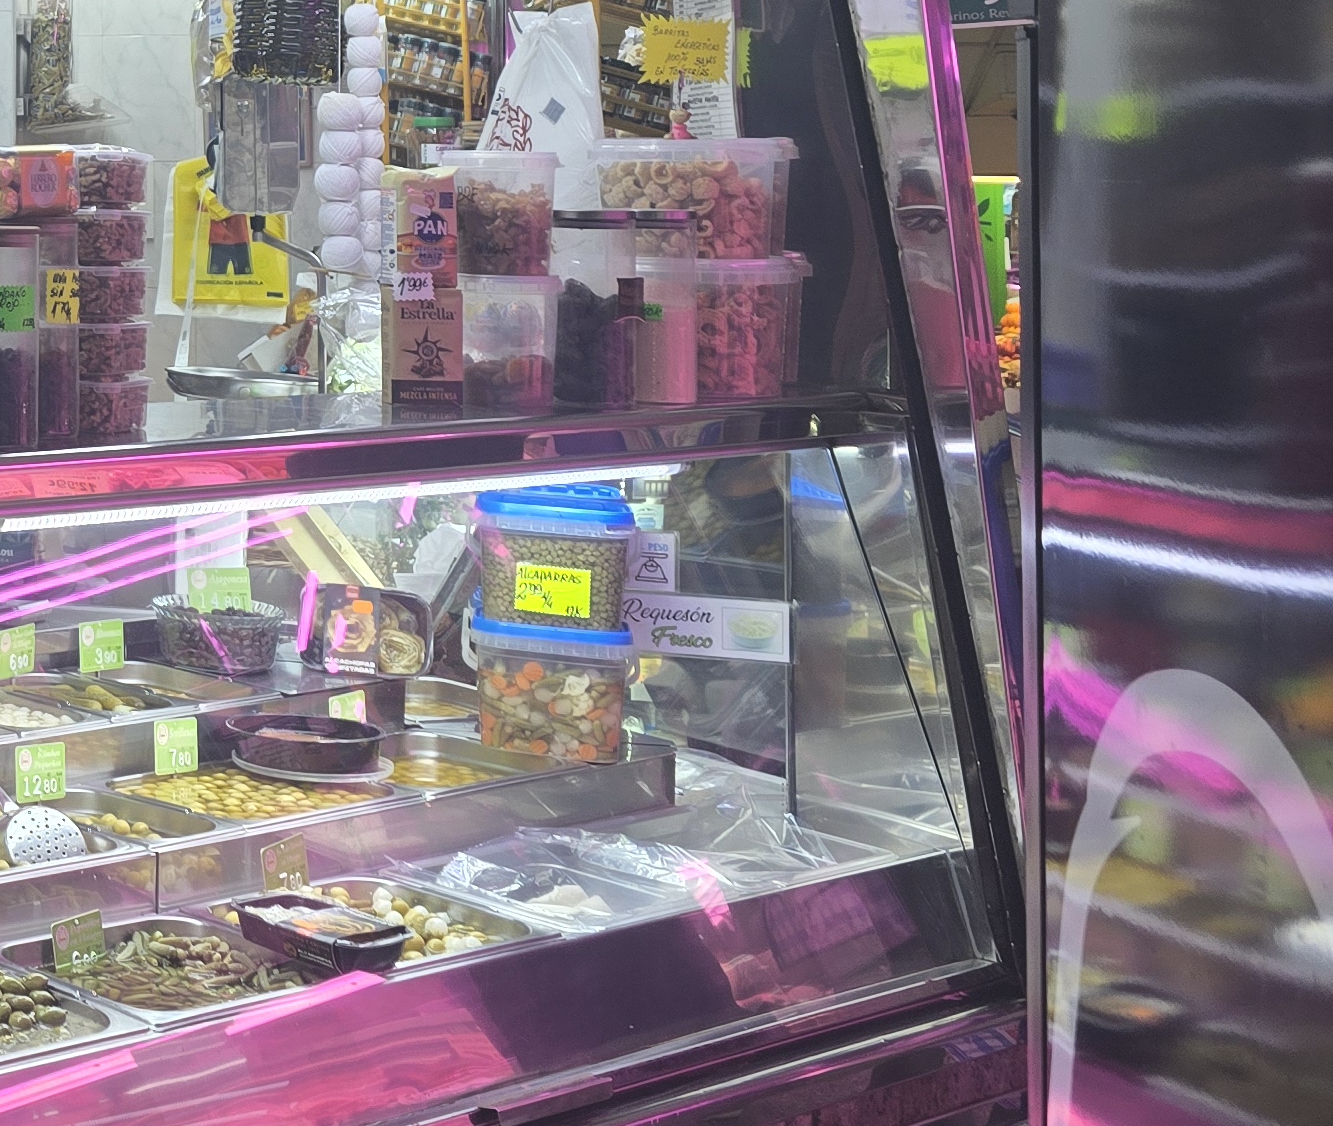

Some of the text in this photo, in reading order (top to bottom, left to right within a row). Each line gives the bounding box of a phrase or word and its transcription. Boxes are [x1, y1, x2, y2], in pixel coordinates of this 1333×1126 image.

[413, 220, 449, 237] PAN
[399, 306, 455, 321] Estrella
[399, 391, 458, 401] MEZCLA INTENSA
[646, 542, 670, 553] PESO
[621, 600, 715, 625] Requesón
[649, 625, 714, 650] Fresco
